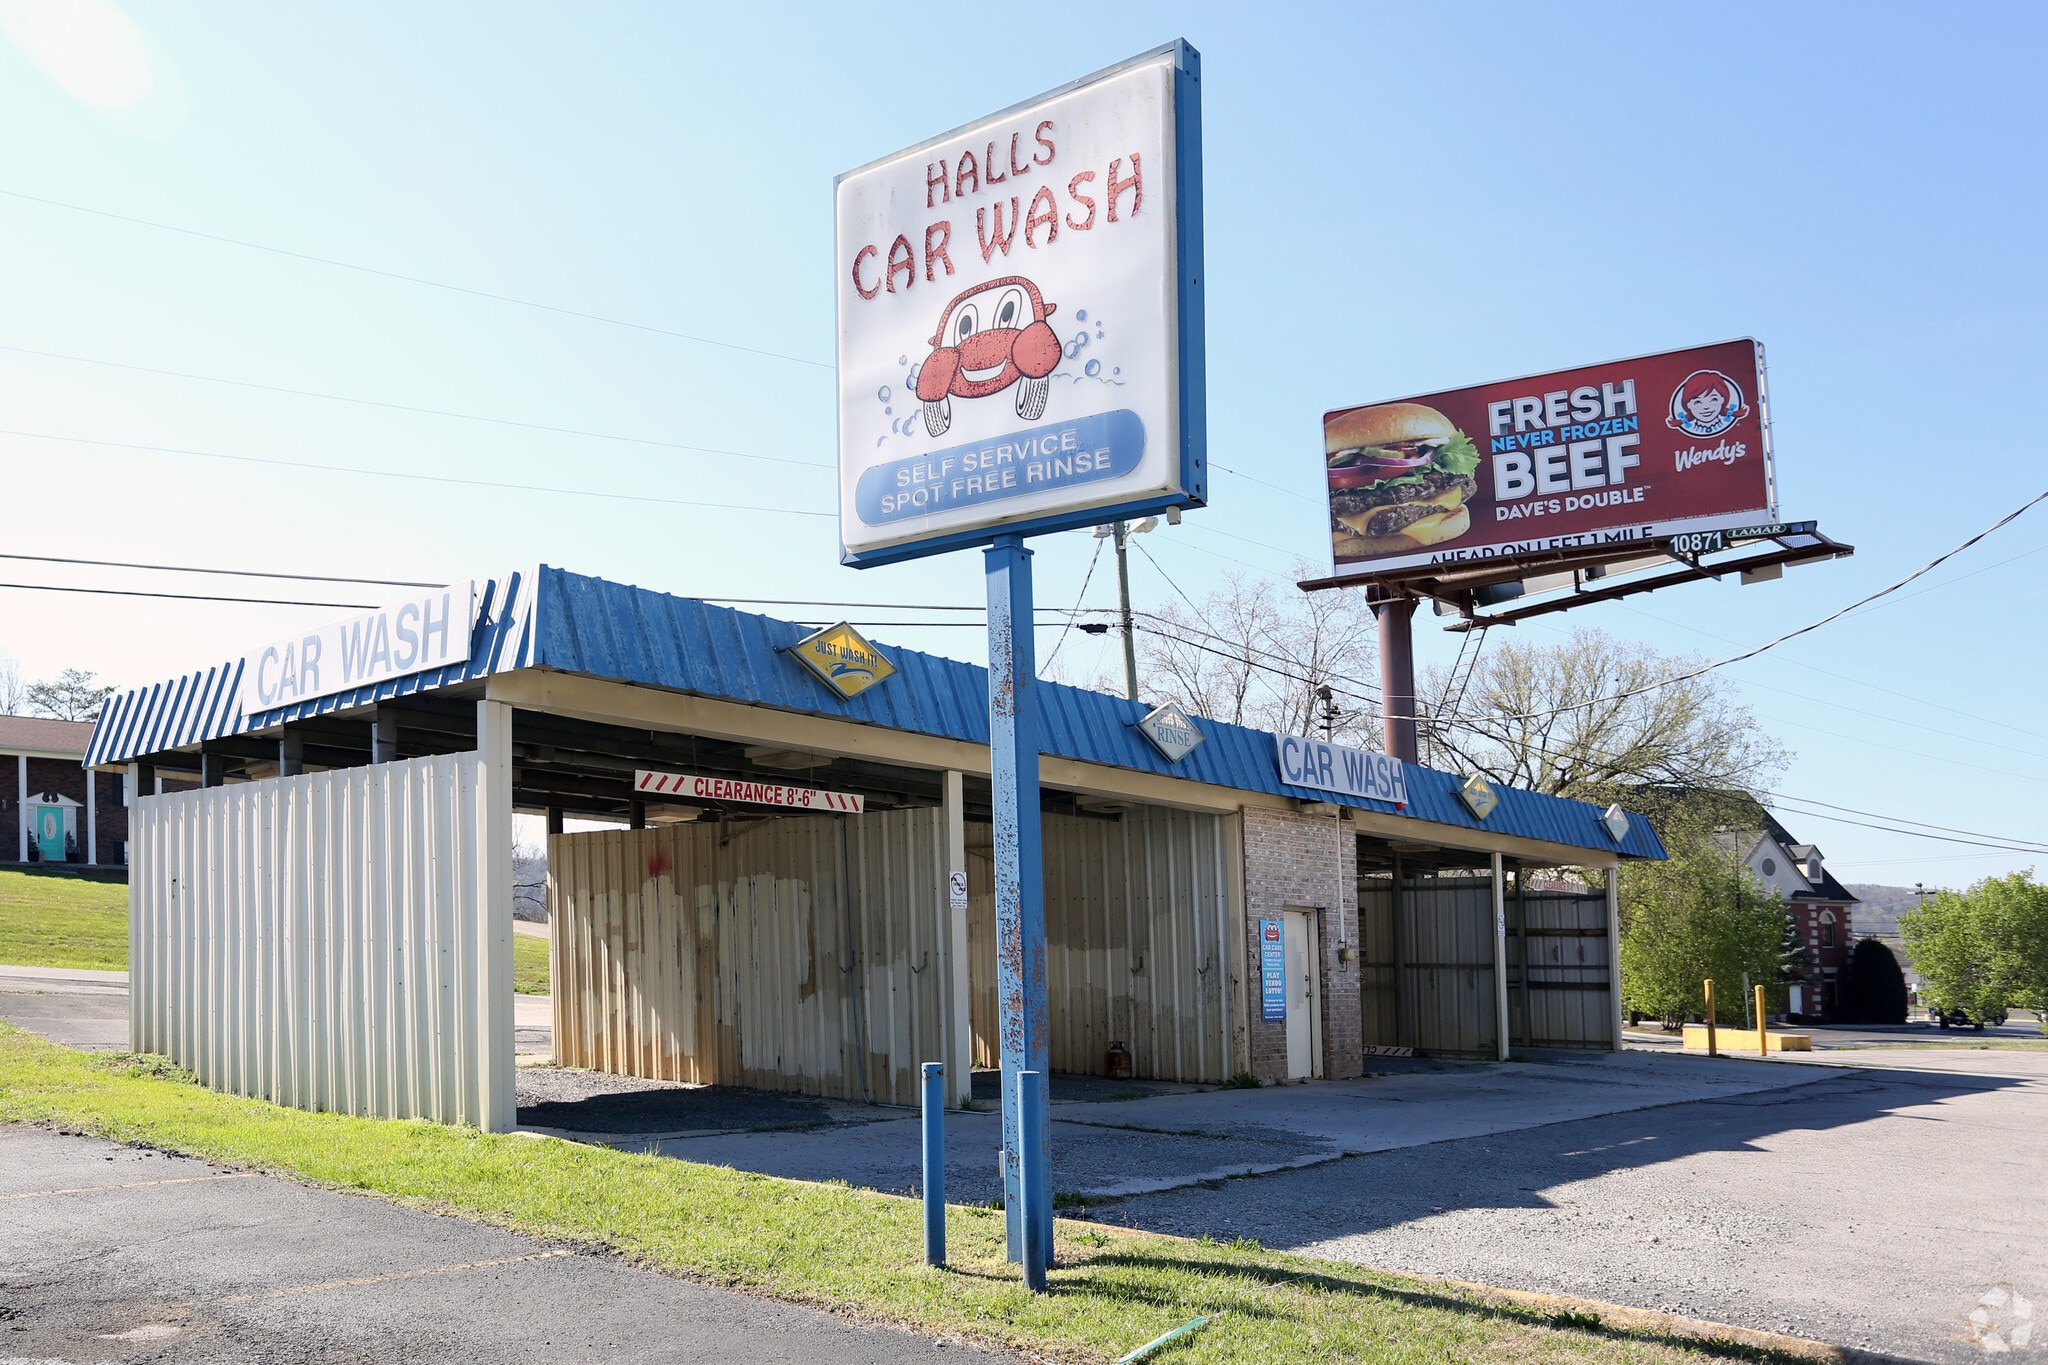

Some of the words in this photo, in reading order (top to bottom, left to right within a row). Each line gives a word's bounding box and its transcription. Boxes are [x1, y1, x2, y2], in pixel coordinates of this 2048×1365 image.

[927, 120, 1056, 208] HALLS
[852, 220, 956, 300] CAR
[977, 152, 1143, 264] WASH
[1487, 378, 1637, 436] FRESH
[896, 456, 954, 487] SELF
[963, 429, 1078, 472] SERVICE
[1491, 430, 1555, 453] NEVER
[1561, 415, 1639, 442] FROZEN
[1674, 438, 1746, 473] Wendy's
[880, 483, 943, 515] SPOT
[951, 466, 1017, 499] FREE
[1026, 447, 1112, 484] RINSE
[1492, 433, 1640, 501] BEEF
[1496, 499, 1562, 521] DAVE'S
[1732, 524, 1781, 537] LAMAR
[1670, 531, 1721, 553] 10871
[257, 634, 322, 706] CAR
[340, 593, 450, 684] WASH
[815, 640, 837, 657] JUST
[840, 646, 865, 664] WASH
[867, 653, 878, 667] IT!
[1157, 726, 1191, 747] RINSE
[694, 778, 783, 804] CLEARANCE
[1282, 737, 1335, 787] CAR
[1342, 749, 1406, 800] WASH
